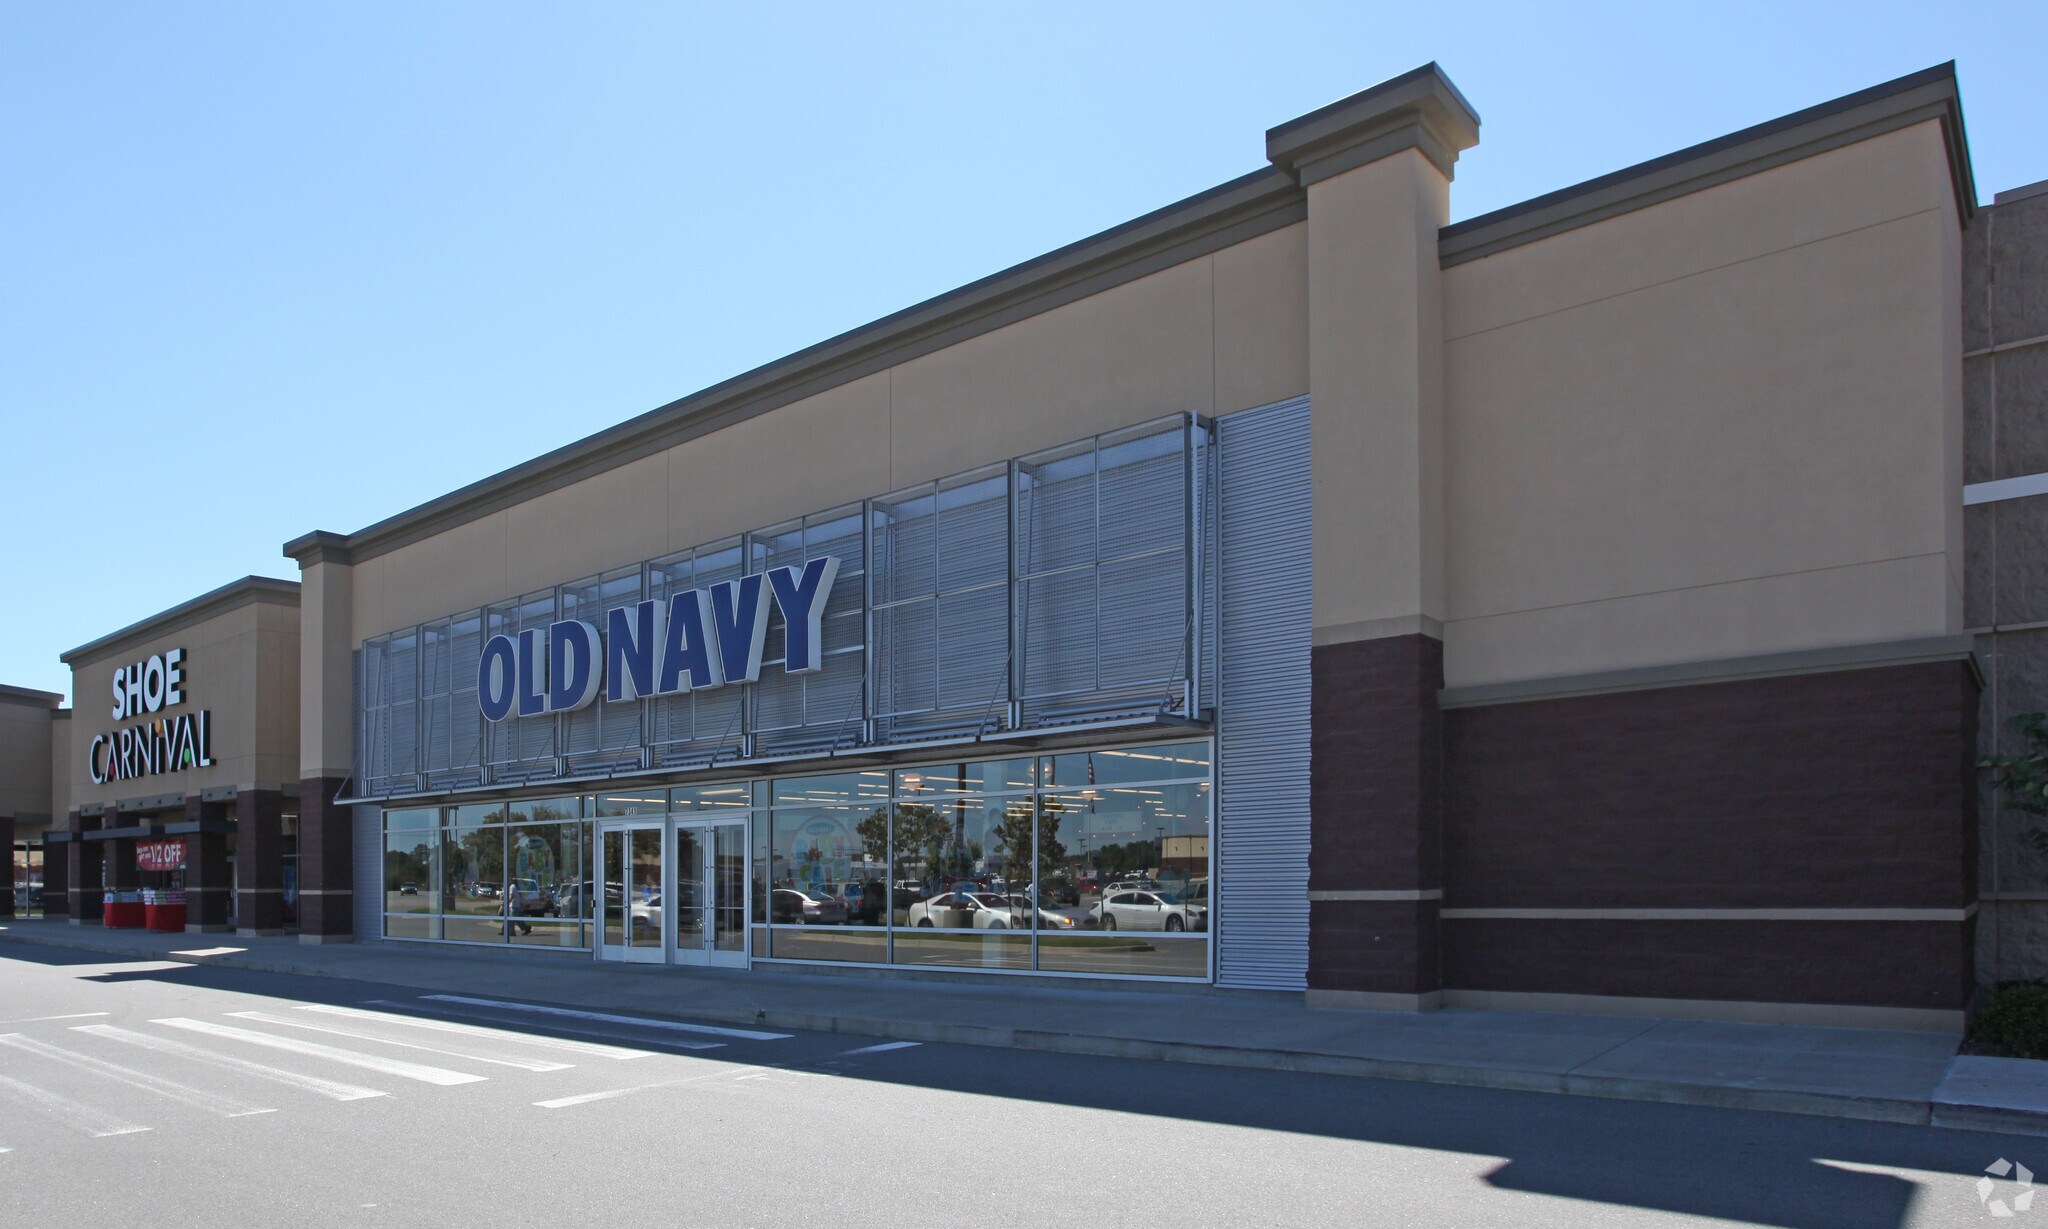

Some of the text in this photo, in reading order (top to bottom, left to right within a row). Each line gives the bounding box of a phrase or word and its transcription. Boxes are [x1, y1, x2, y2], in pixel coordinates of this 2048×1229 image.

[477, 555, 841, 722] OLD NAVY
[112, 648, 186, 720] SHOE
[150, 843, 162, 863] 1/2
[164, 844, 181, 862] OFF
